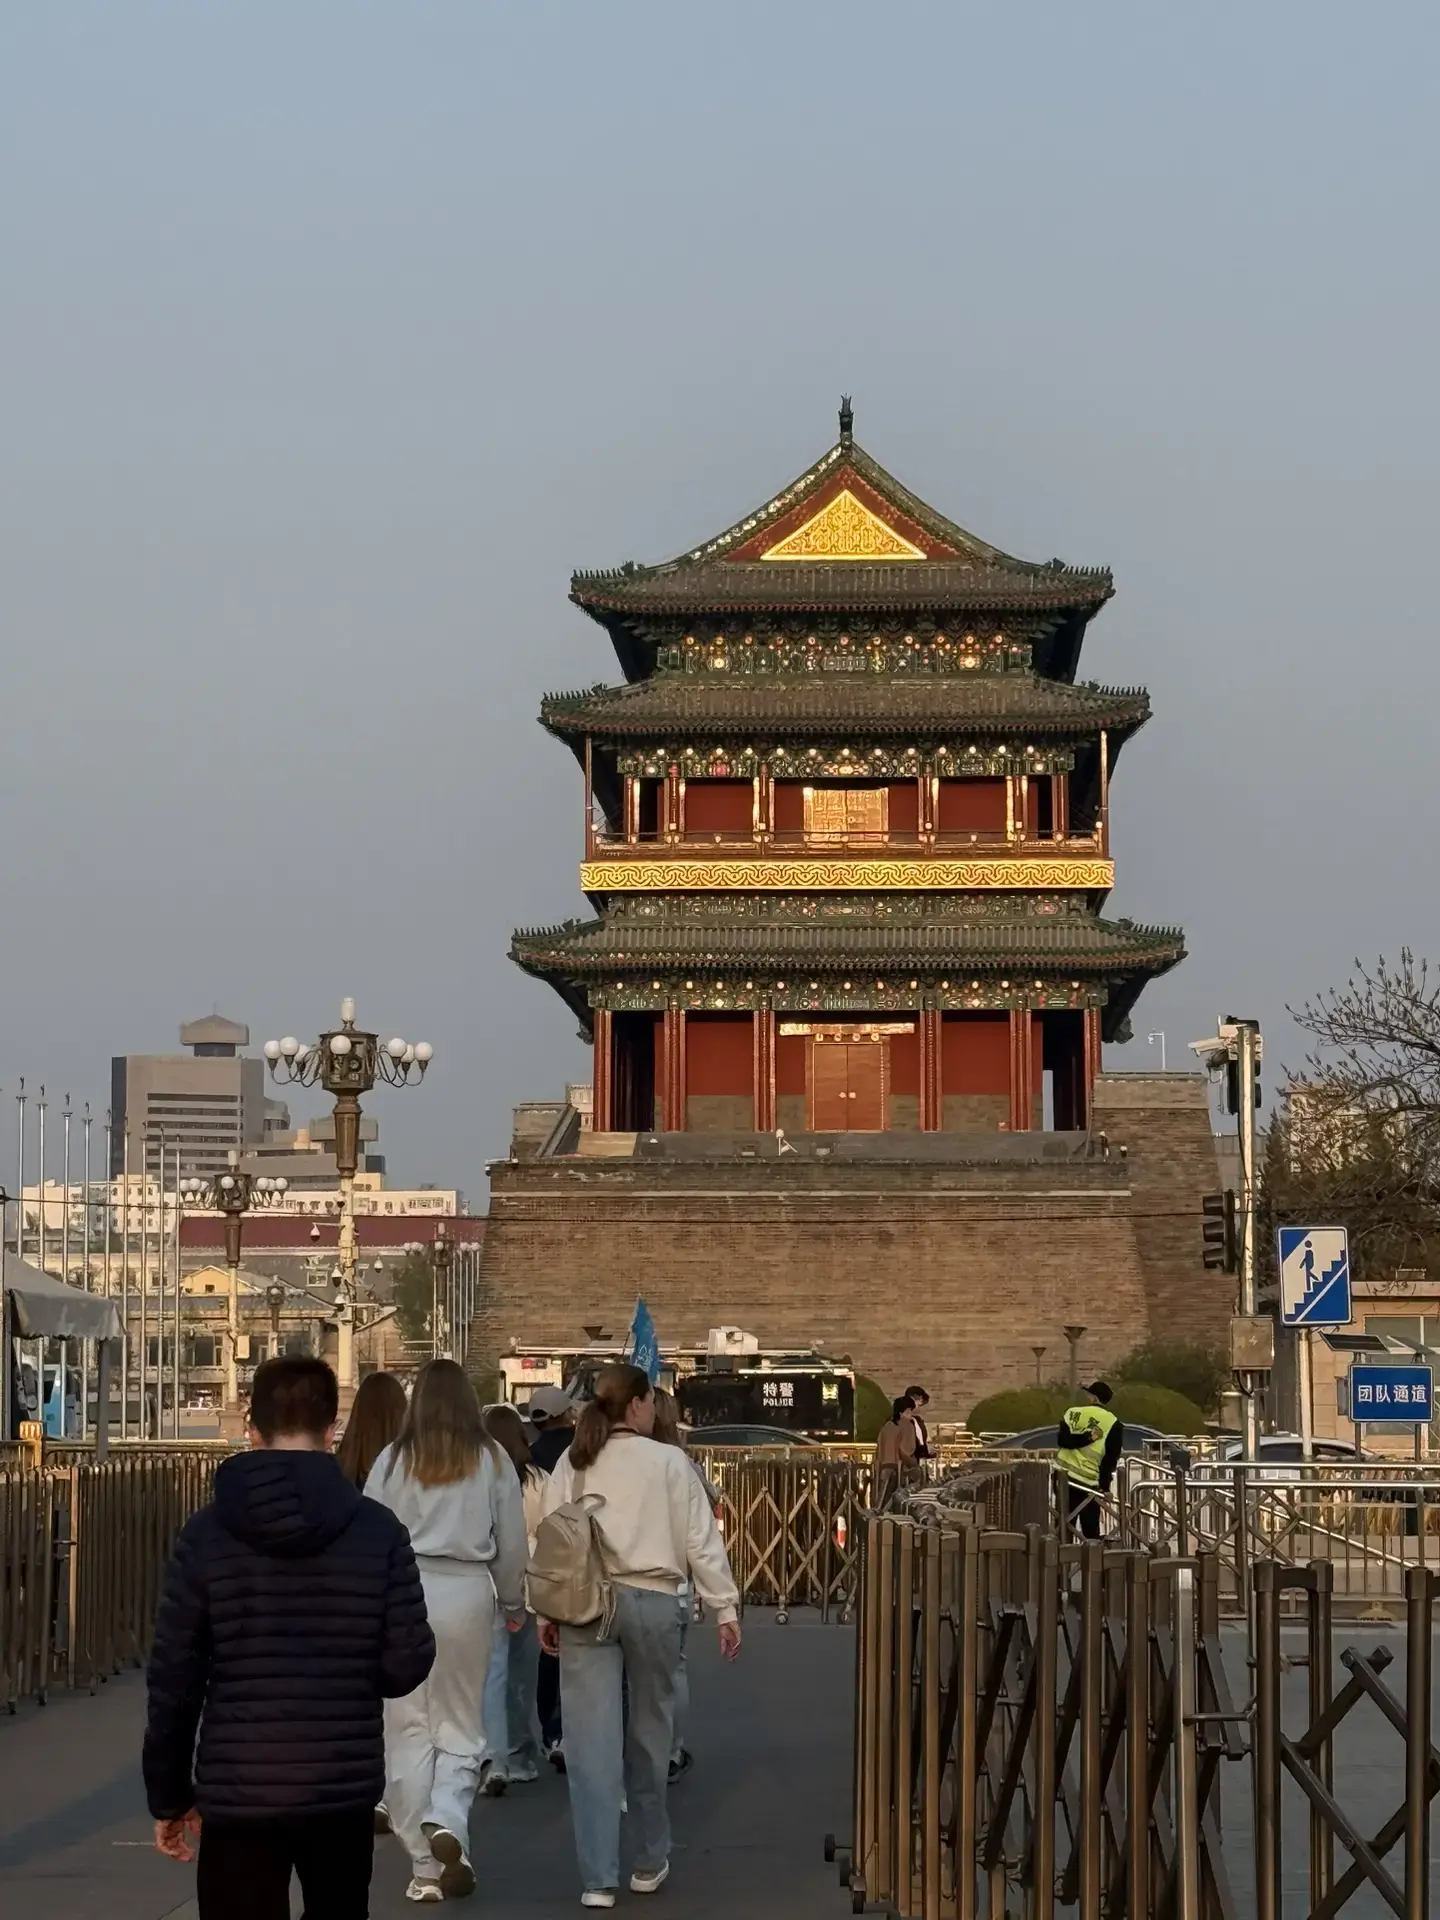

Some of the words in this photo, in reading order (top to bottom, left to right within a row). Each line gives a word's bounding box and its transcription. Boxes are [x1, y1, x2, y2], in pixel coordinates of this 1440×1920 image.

[763, 1382, 793, 1397] 特警
[1358, 1384, 1427, 1403] 团队通道
[763, 1398, 794, 1406] POLICE
